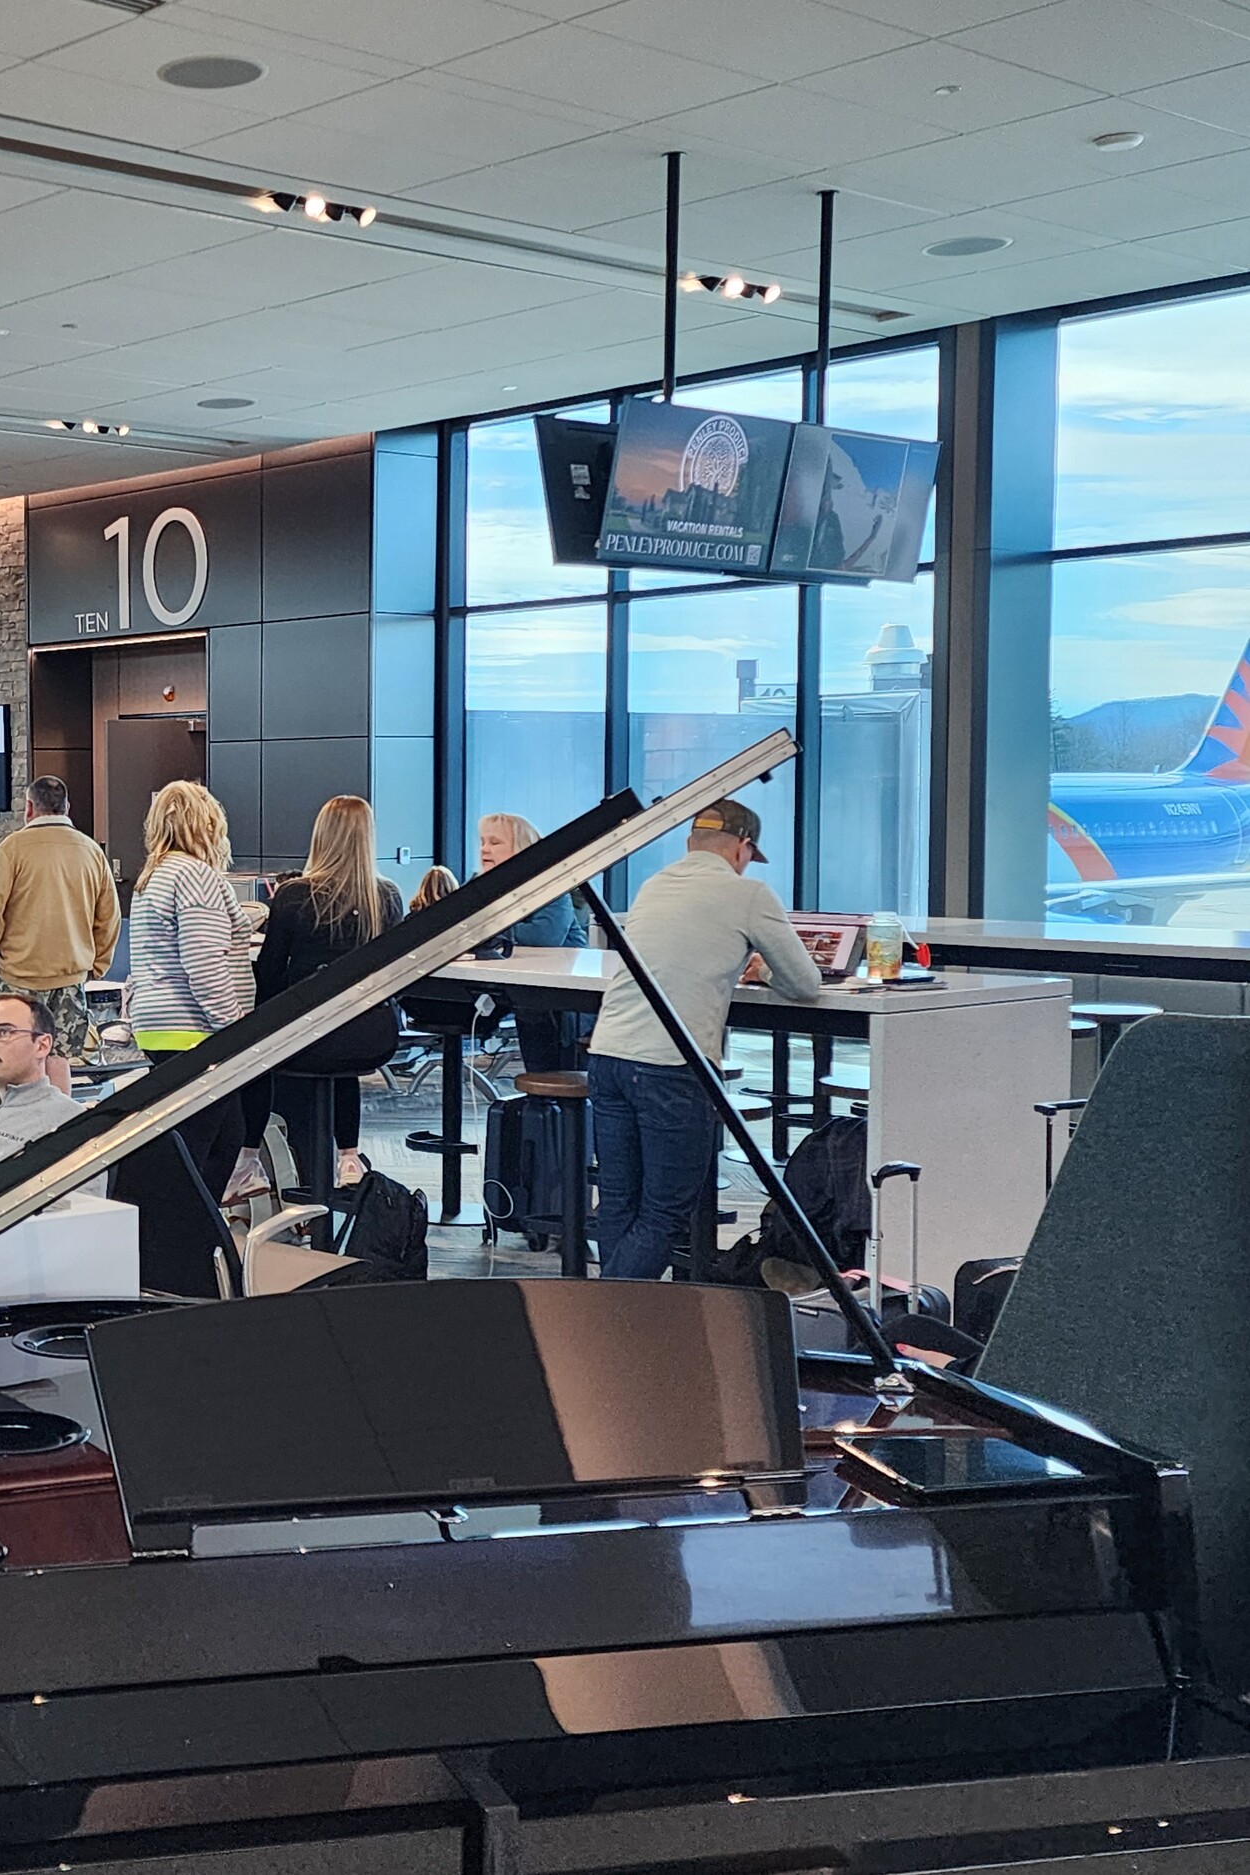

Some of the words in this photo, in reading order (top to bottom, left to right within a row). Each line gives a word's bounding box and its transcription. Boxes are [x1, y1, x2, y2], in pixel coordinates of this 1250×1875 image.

[688, 420, 718, 457] PENLEY
[666, 519, 708, 535] VACATION
[708, 524, 744, 538] RENTALS
[605, 533, 745, 562] PENLEYPRODUCE.COM
[74, 610, 109, 634] TEN
[103, 506, 208, 631] 10
